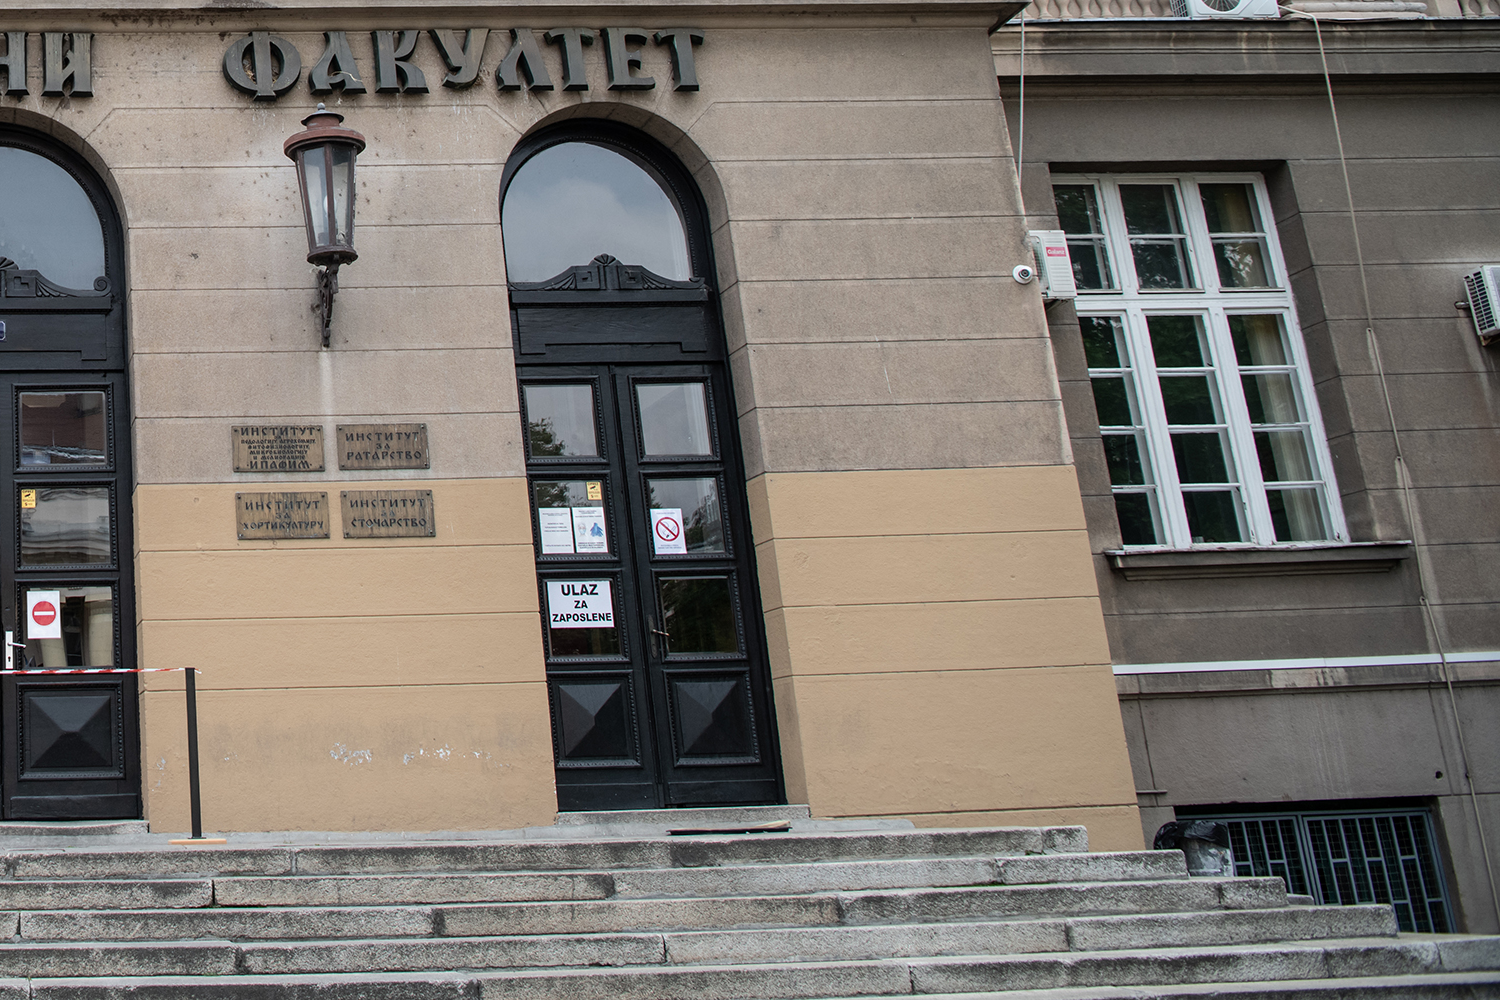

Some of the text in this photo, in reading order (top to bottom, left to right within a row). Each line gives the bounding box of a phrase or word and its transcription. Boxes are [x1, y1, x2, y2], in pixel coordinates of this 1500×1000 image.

[221, 27, 705, 101] ФАКУЛТЕТ
[241, 428, 315, 436] ИНСТИТУТ
[346, 432, 419, 441] ИНСТИТУТ
[347, 451, 421, 460] РАТАРСТВО
[246, 501, 319, 510] ИНСТИТУТ
[350, 499, 424, 508] ИНСТИТУТ
[243, 521, 323, 530] ХОРТИКУЛТУРУ
[351, 518, 427, 527] СТОЧАРСТВО
[561, 584, 598, 596] ULAZ
[574, 600, 588, 609] ZA
[552, 613, 612, 622] ZAPOSLENE
